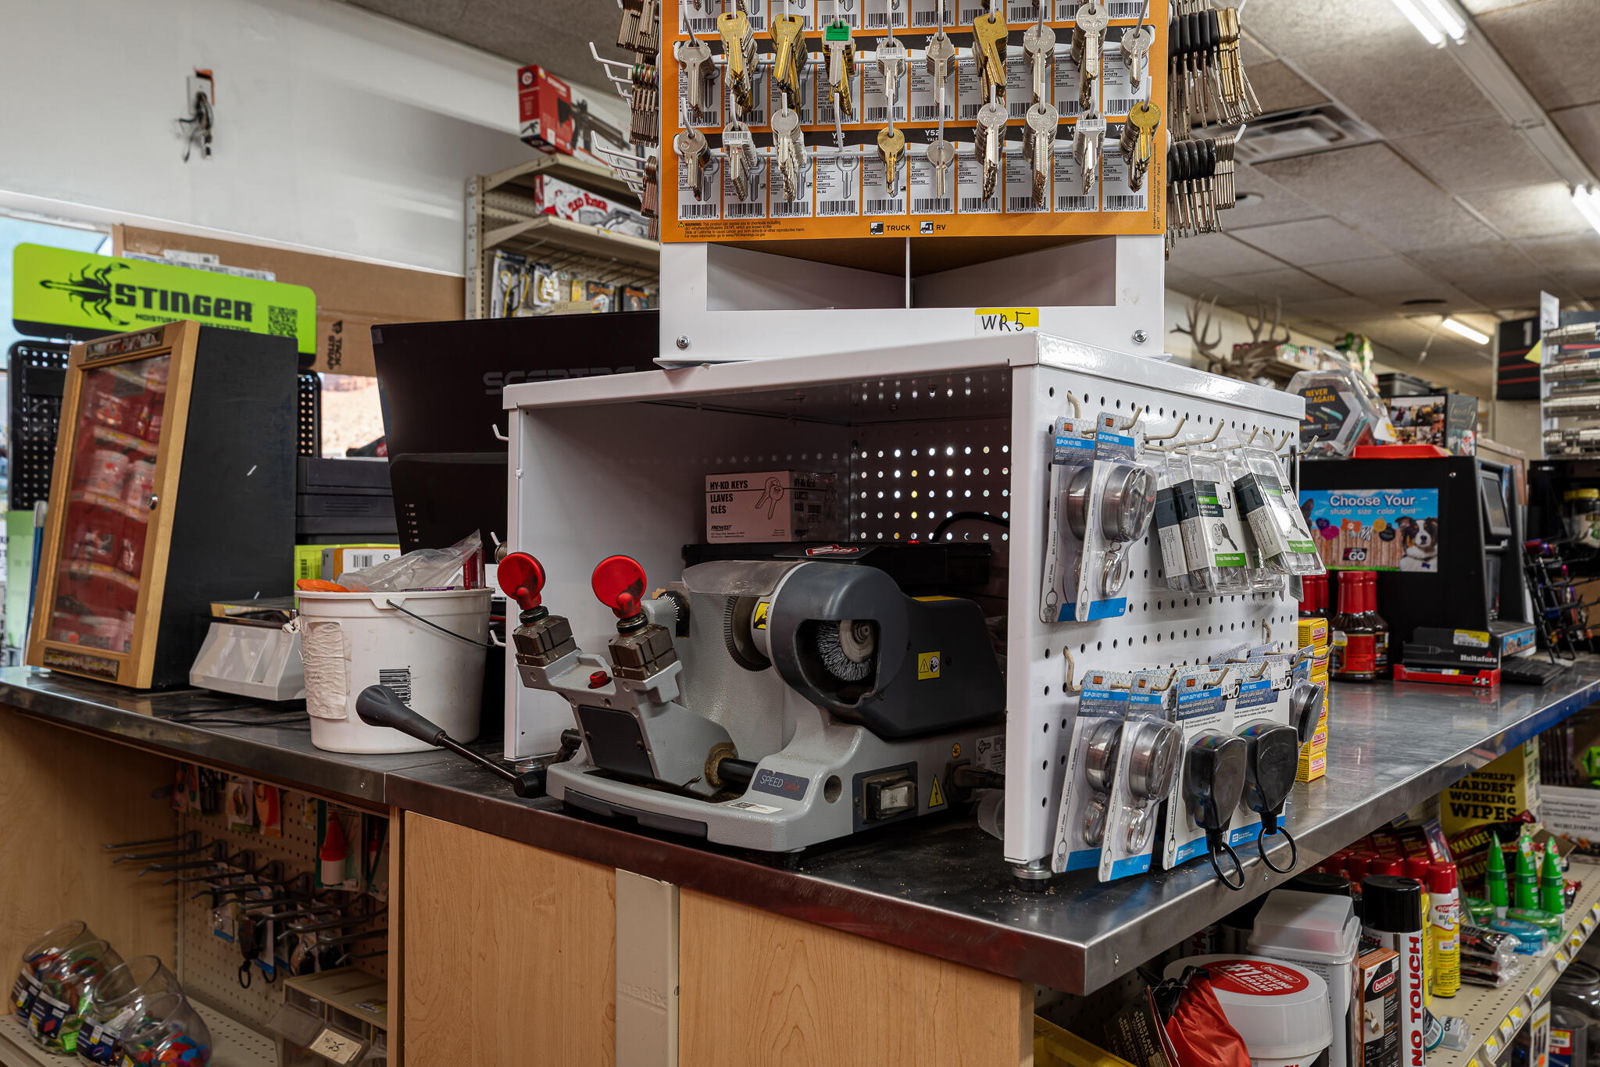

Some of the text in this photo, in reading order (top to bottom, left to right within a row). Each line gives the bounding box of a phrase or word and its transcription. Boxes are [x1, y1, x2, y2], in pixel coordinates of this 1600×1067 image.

[115, 283, 252, 322] STINGER
[731, 480, 748, 489] KEYS
[710, 493, 733, 503] LLAVES
[1330, 494, 1416, 507] Choose Your
[760, 774, 784, 788] SPEED
[1449, 791, 1516, 805] WORKING
[1449, 803, 1517, 821] WIPES
[1450, 830, 1491, 854] VALUE!
[1408, 936, 1422, 1023] TOUCH
[1411, 1030, 1423, 1067] NO
